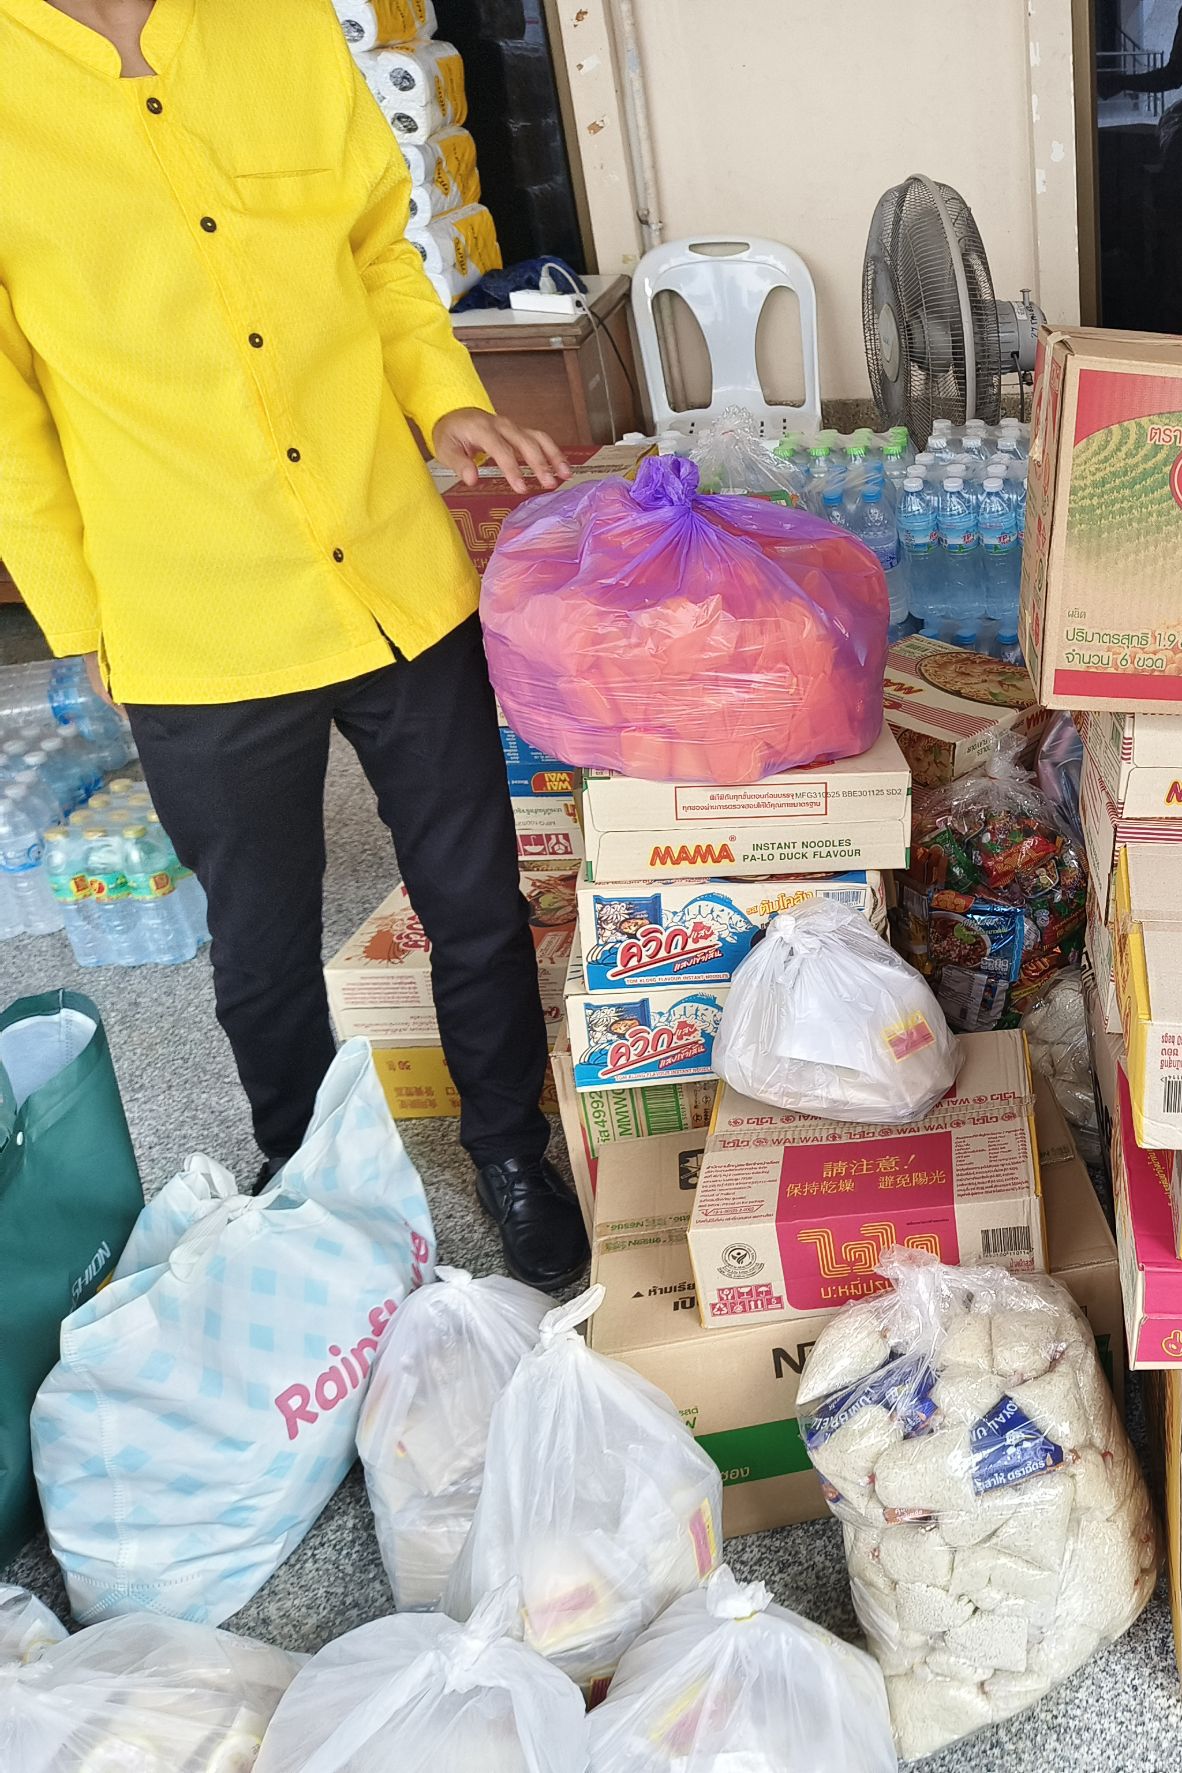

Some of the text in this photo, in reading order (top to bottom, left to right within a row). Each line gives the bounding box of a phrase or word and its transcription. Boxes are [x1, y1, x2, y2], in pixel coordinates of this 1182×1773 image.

[1149, 427, 1182, 444] ตรา
[1065, 628, 1151, 648] ปริมาตรสุทธิ
[1155, 631, 1177, 647] 1.9
[1065, 649, 1165, 670] จำนวน 6 ขวด
[649, 839, 852, 868] MAMA INSTANT NOODLES
[742, 849, 861, 863] PA-LO DUCK FLAVOUR
[620, 926, 689, 968] ควิก
[610, 1027, 673, 1067] ควิก
[771, 1123, 948, 1147] WAI WAI WAI WAI
[878, 1171, 946, 1190] 避免陽光
